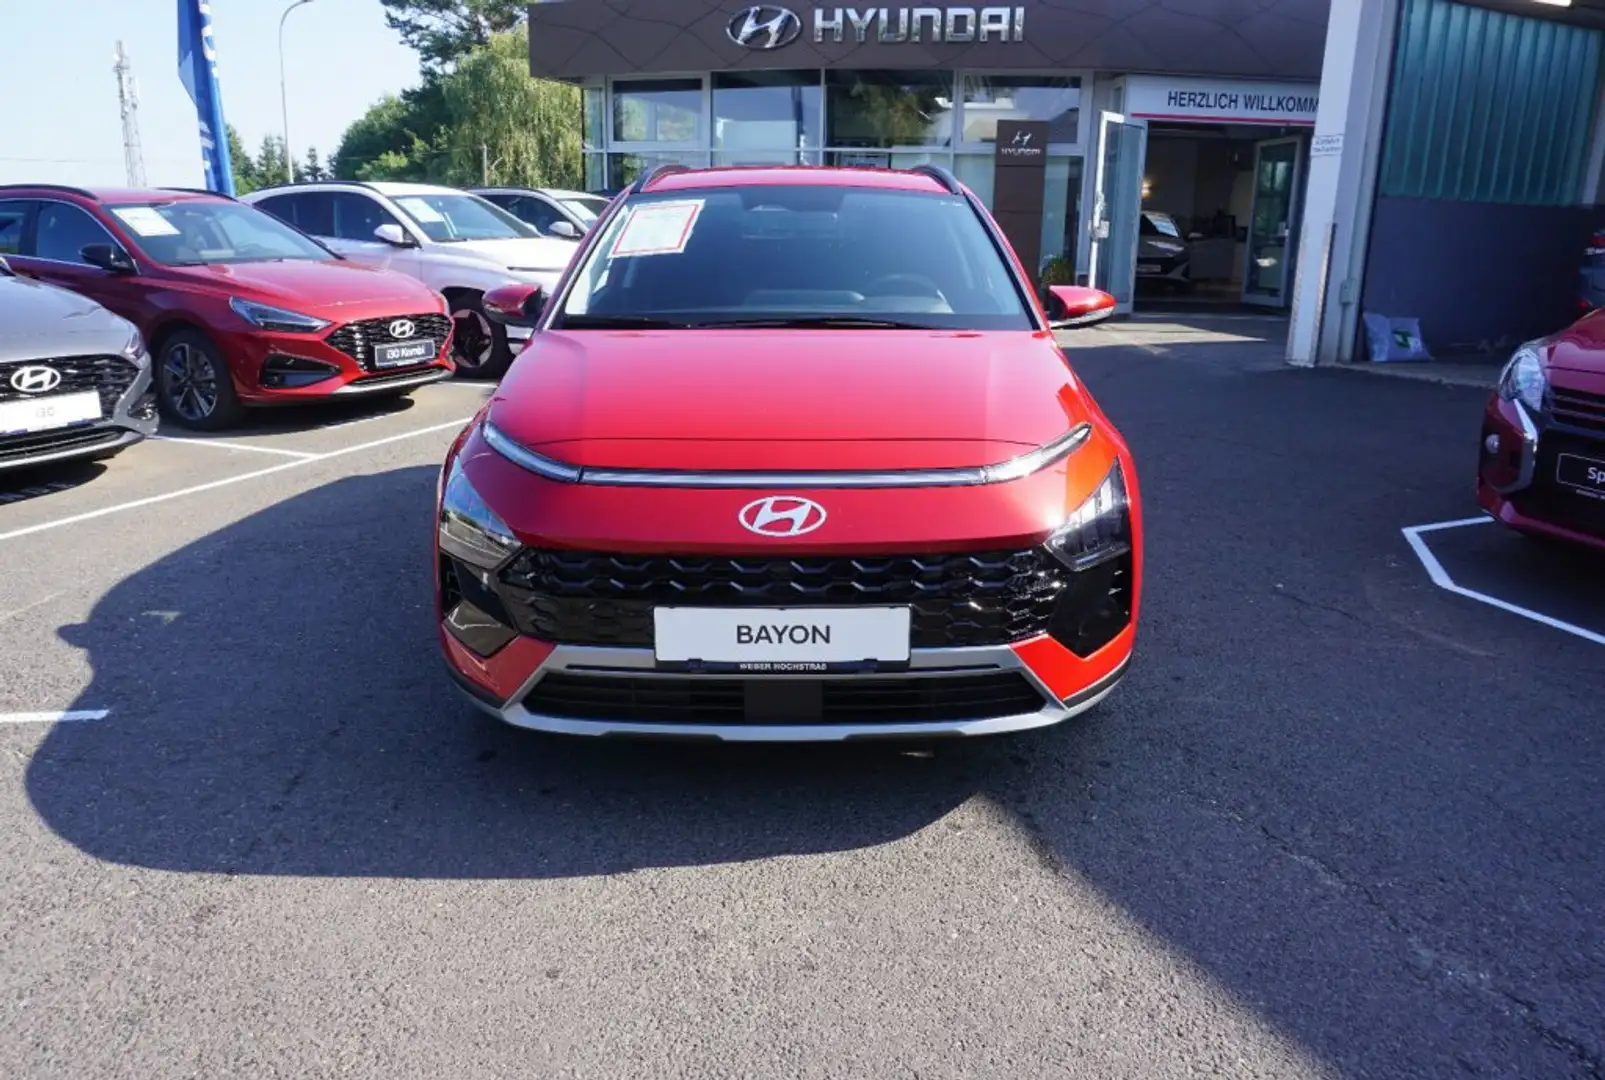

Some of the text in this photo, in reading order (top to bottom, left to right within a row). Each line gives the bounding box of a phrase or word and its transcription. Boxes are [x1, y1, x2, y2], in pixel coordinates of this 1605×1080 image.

[813, 7, 1025, 43] HYUNDAI
[1167, 91, 1239, 110] HERZLICH
[736, 624, 831, 645] BAYON
[739, 662, 771, 671] WEBER
